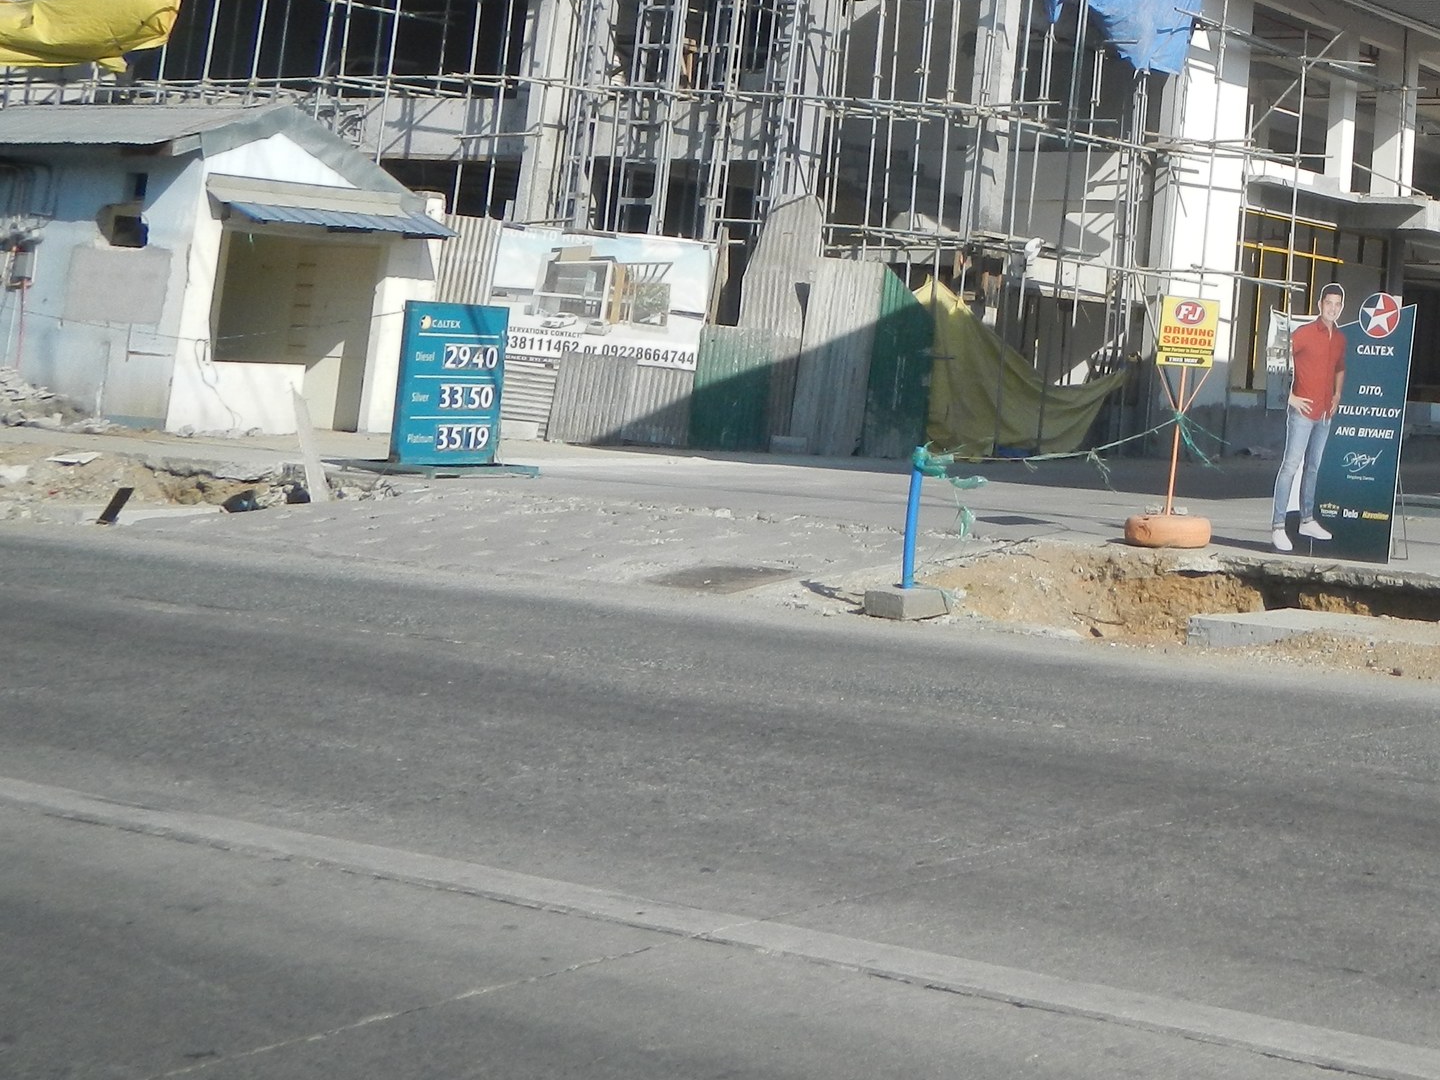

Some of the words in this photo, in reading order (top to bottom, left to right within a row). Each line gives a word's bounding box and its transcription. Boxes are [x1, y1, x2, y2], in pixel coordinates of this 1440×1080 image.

[1177, 304, 1203, 321] FJ
[431, 319, 461, 329] CALTEX
[1163, 325, 1215, 338] DRIVING
[1162, 335, 1213, 347] SCHOOL
[505, 335, 579, 353] 38111462
[584, 345, 598, 355] or
[602, 344, 694, 365] 09228664744
[1357, 344, 1395, 357] CALTEX
[416, 351, 435, 362] Diesel
[1358, 385, 1384, 397] DITO,
[411, 393, 429, 403] Silver
[1338, 404, 1401, 418] TULUY-TULOY
[1335, 426, 1356, 437] ANG
[407, 433, 434, 444] Platinum
[1342, 508, 1359, 519] Delo
